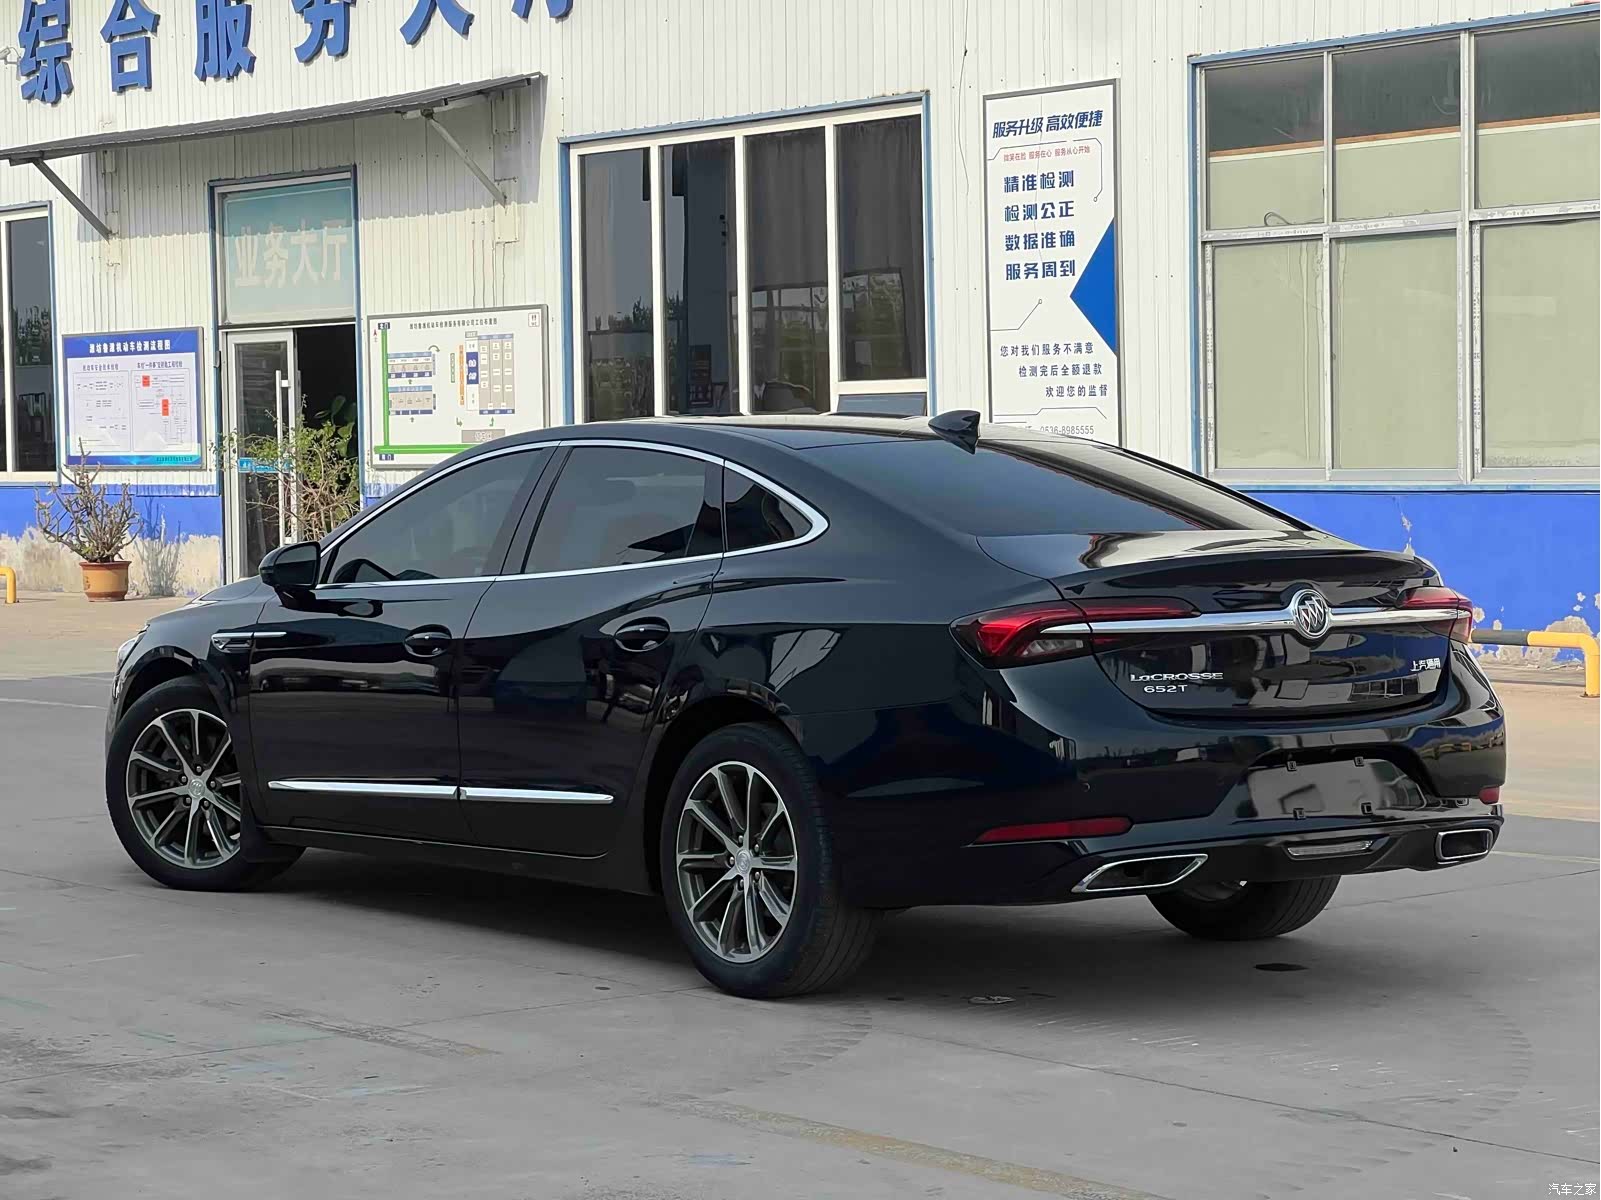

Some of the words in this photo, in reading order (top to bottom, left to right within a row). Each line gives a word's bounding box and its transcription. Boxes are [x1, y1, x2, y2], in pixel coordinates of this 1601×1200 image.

[18, 0, 573, 105] 综合服务
[992, 117, 1043, 138] 服务升级
[1046, 110, 1103, 132] 高效便捷
[1029, 149, 1052, 160] 服务在心
[1003, 170, 1074, 193] 精准检测
[1004, 201, 1074, 222] 检测公正
[1005, 230, 1075, 251] 数据准确
[234, 221, 348, 288] 业务大厅
[1006, 259, 1075, 280] 服务周到
[1000, 341, 1094, 357] 您对我们服务不满意
[1018, 362, 1103, 378] 检测完后全额退款
[1045, 384, 1108, 398] 欢迎您的监督
[1410, 658, 1440, 671] 上汽通用
[1143, 684, 1188, 693] 652T
